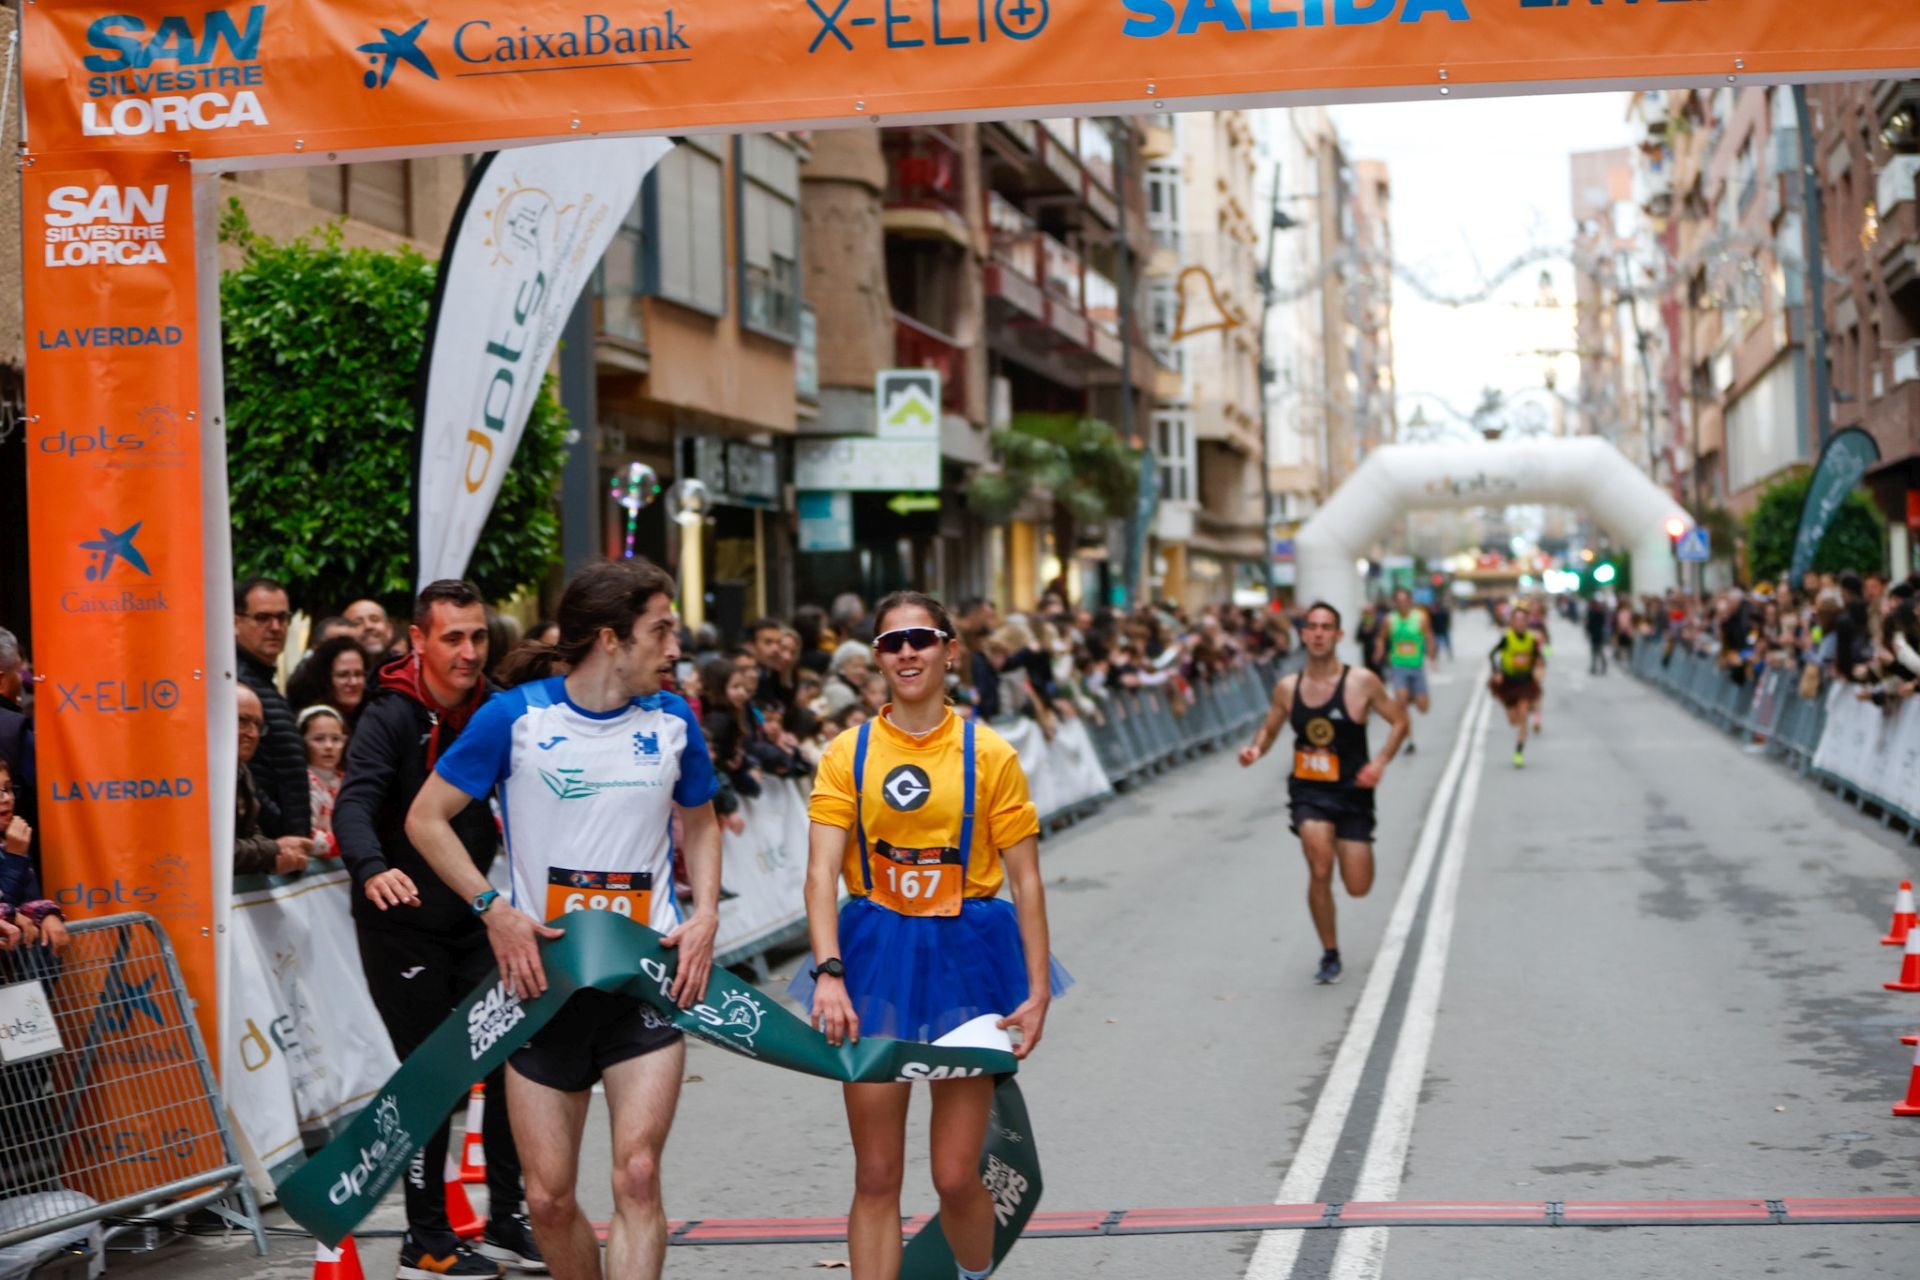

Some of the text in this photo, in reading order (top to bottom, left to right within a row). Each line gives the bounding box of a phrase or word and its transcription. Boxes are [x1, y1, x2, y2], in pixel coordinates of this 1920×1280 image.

[84, 5, 265, 73] SAN
[453, 13, 692, 64] CaixaBank
[88, 65, 263, 98] SILVESTRE
[81, 91, 269, 137] LORCA
[44, 184, 169, 226] SAN
[45, 224, 165, 243] SILVESTRE
[44, 240, 167, 267] LORCA
[39, 326, 182, 349] LA VERDAD
[40, 425, 144, 457] dpts
[60, 590, 169, 613] CaixaBank
[52, 777, 193, 801] LA VERDAD
[55, 880, 157, 909] dpts
[886, 865, 942, 899] 167
[471, 1005, 526, 1061] LORCA
